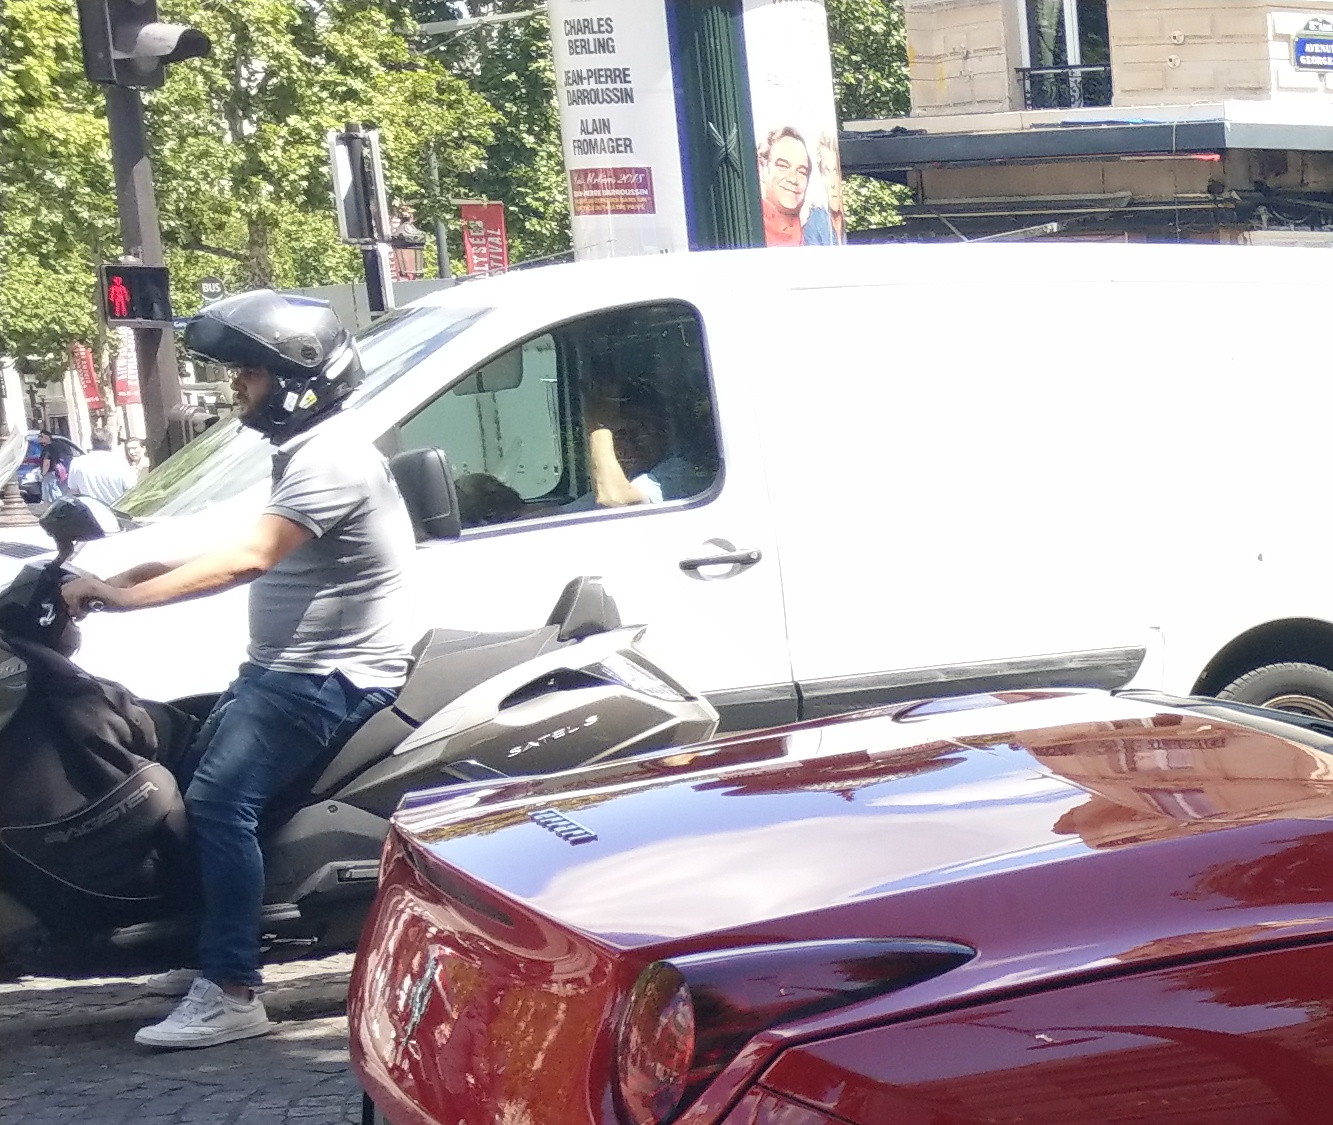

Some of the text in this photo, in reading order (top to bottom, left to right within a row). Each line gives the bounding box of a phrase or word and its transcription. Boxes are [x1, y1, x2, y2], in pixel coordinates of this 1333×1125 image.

[564, 17, 614, 36] CHARLES
[568, 37, 616, 56] BERLING
[1300, 55, 1333, 65] GEORGE
[564, 68, 632, 87] JEAN-PIERRE
[566, 87, 634, 106] DARROUSSIN
[580, 118, 611, 135] ALAIN
[573, 138, 634, 156] FROMAGER
[201, 282, 221, 293] BUS
